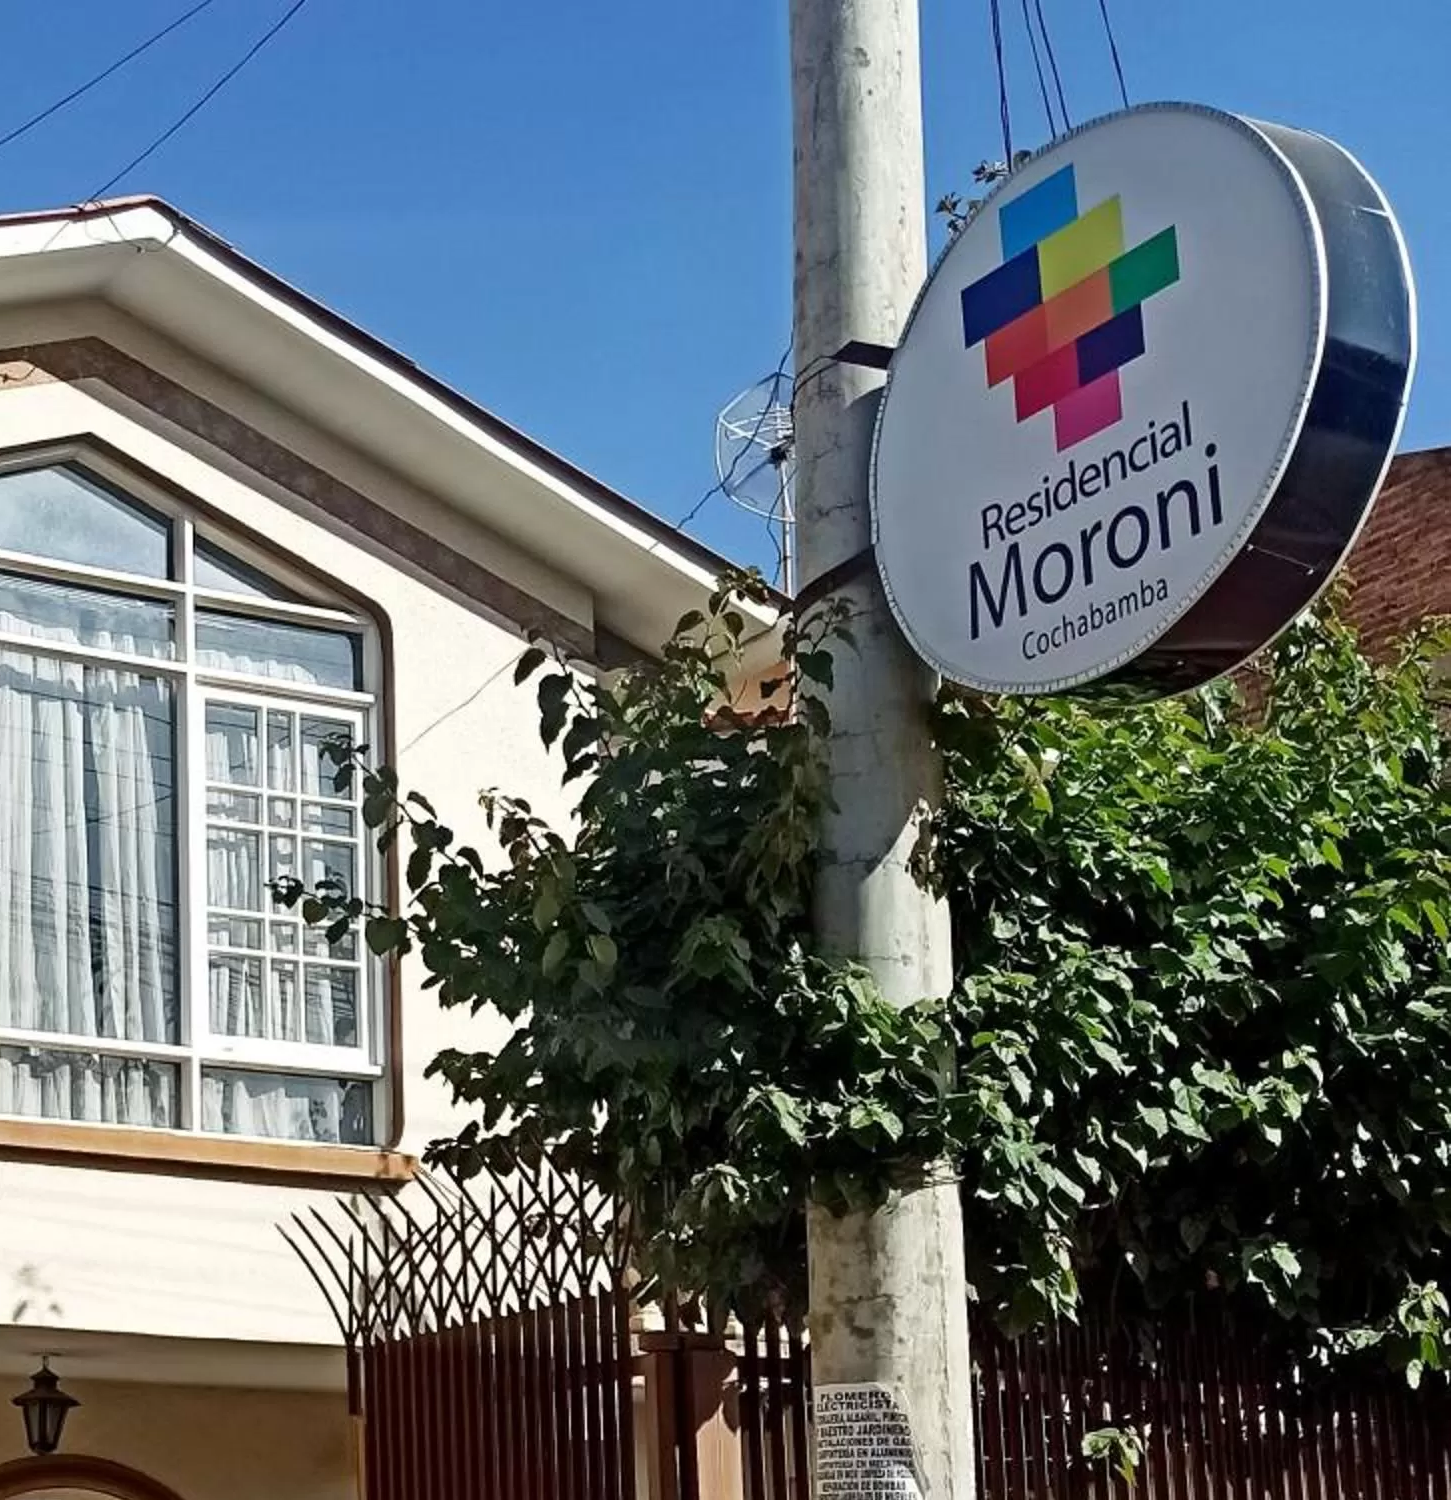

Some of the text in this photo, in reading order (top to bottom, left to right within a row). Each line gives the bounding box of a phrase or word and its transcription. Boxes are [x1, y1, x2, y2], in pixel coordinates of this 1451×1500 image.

[969, 443, 1223, 639] Moroni
[981, 400, 1192, 548] Residencial
[1021, 576, 1168, 660] Cochabamba
